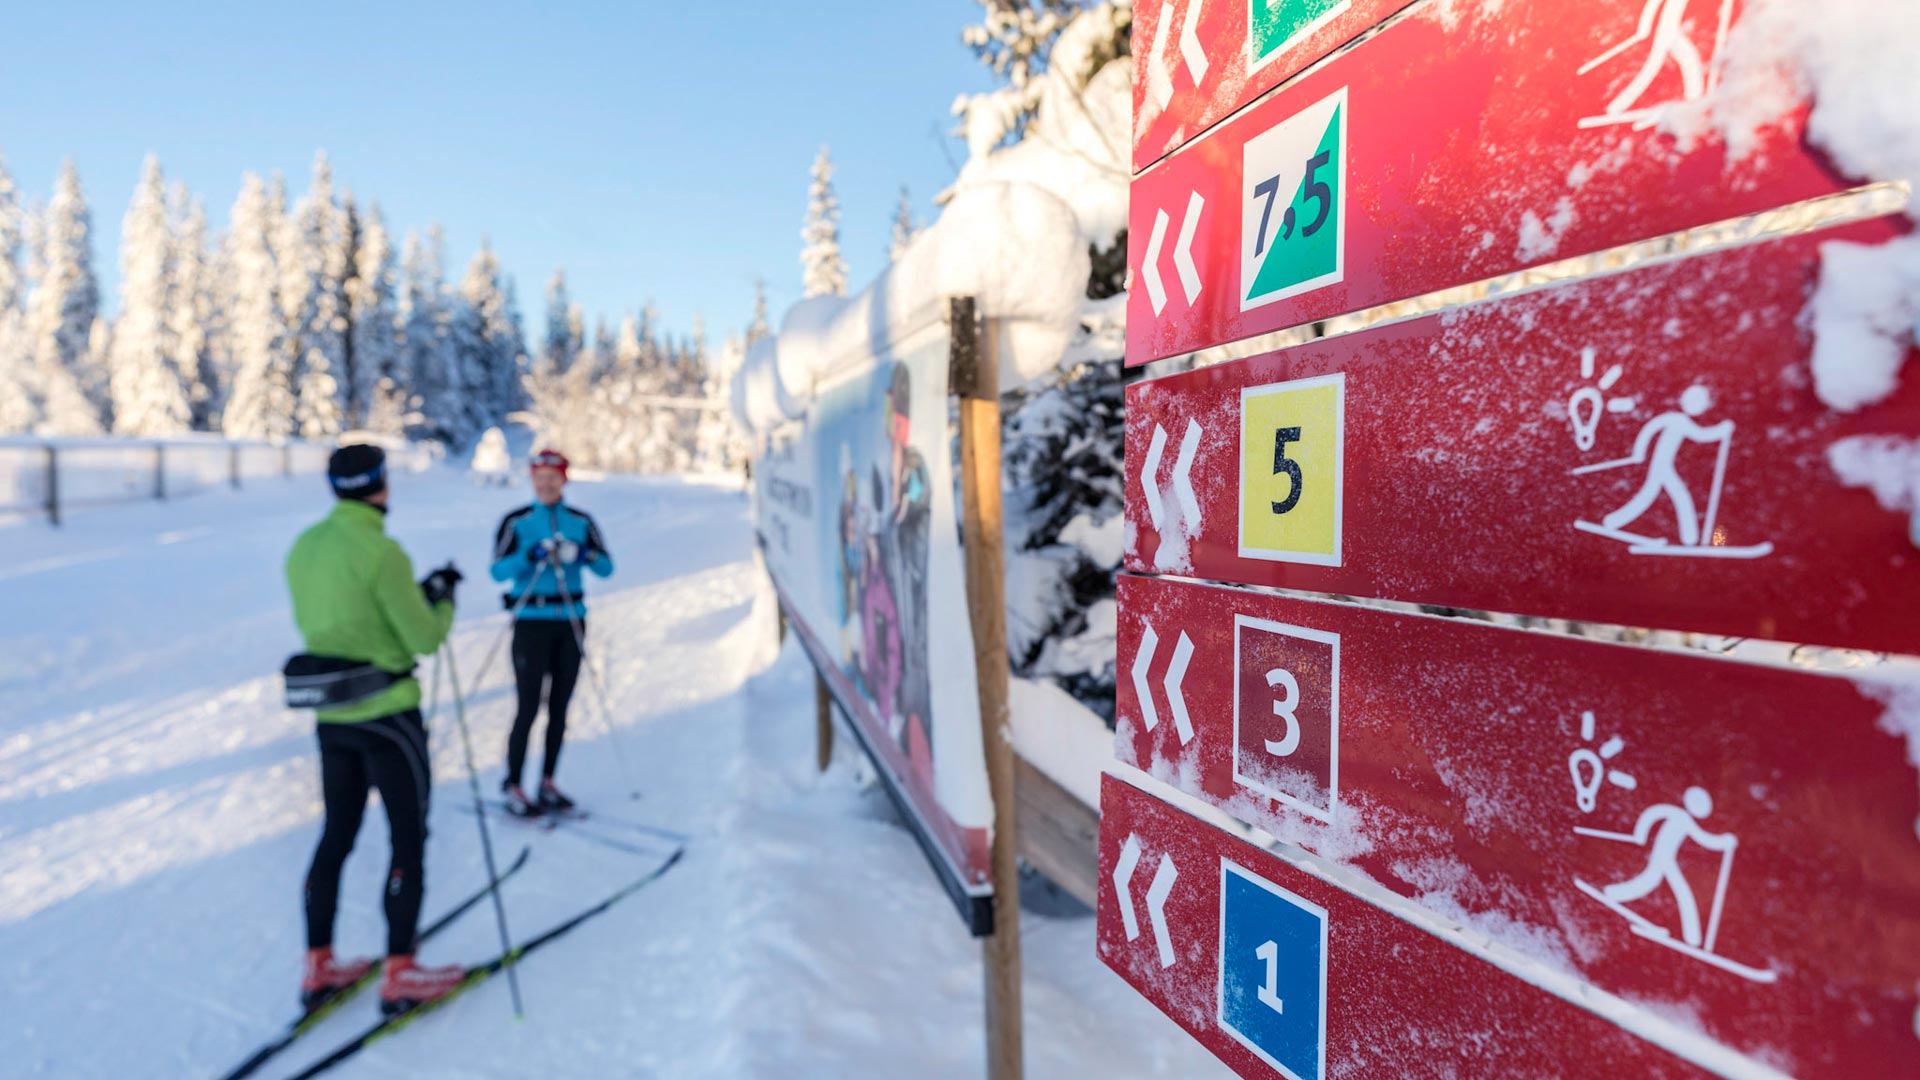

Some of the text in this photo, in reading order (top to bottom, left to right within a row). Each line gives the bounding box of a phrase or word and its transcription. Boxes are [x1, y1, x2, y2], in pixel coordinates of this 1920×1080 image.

[1253, 149, 1332, 259] 7,5
[1271, 426, 1303, 515] 5
[1264, 668, 1301, 757] 3
[1255, 939, 1283, 1015] 1
